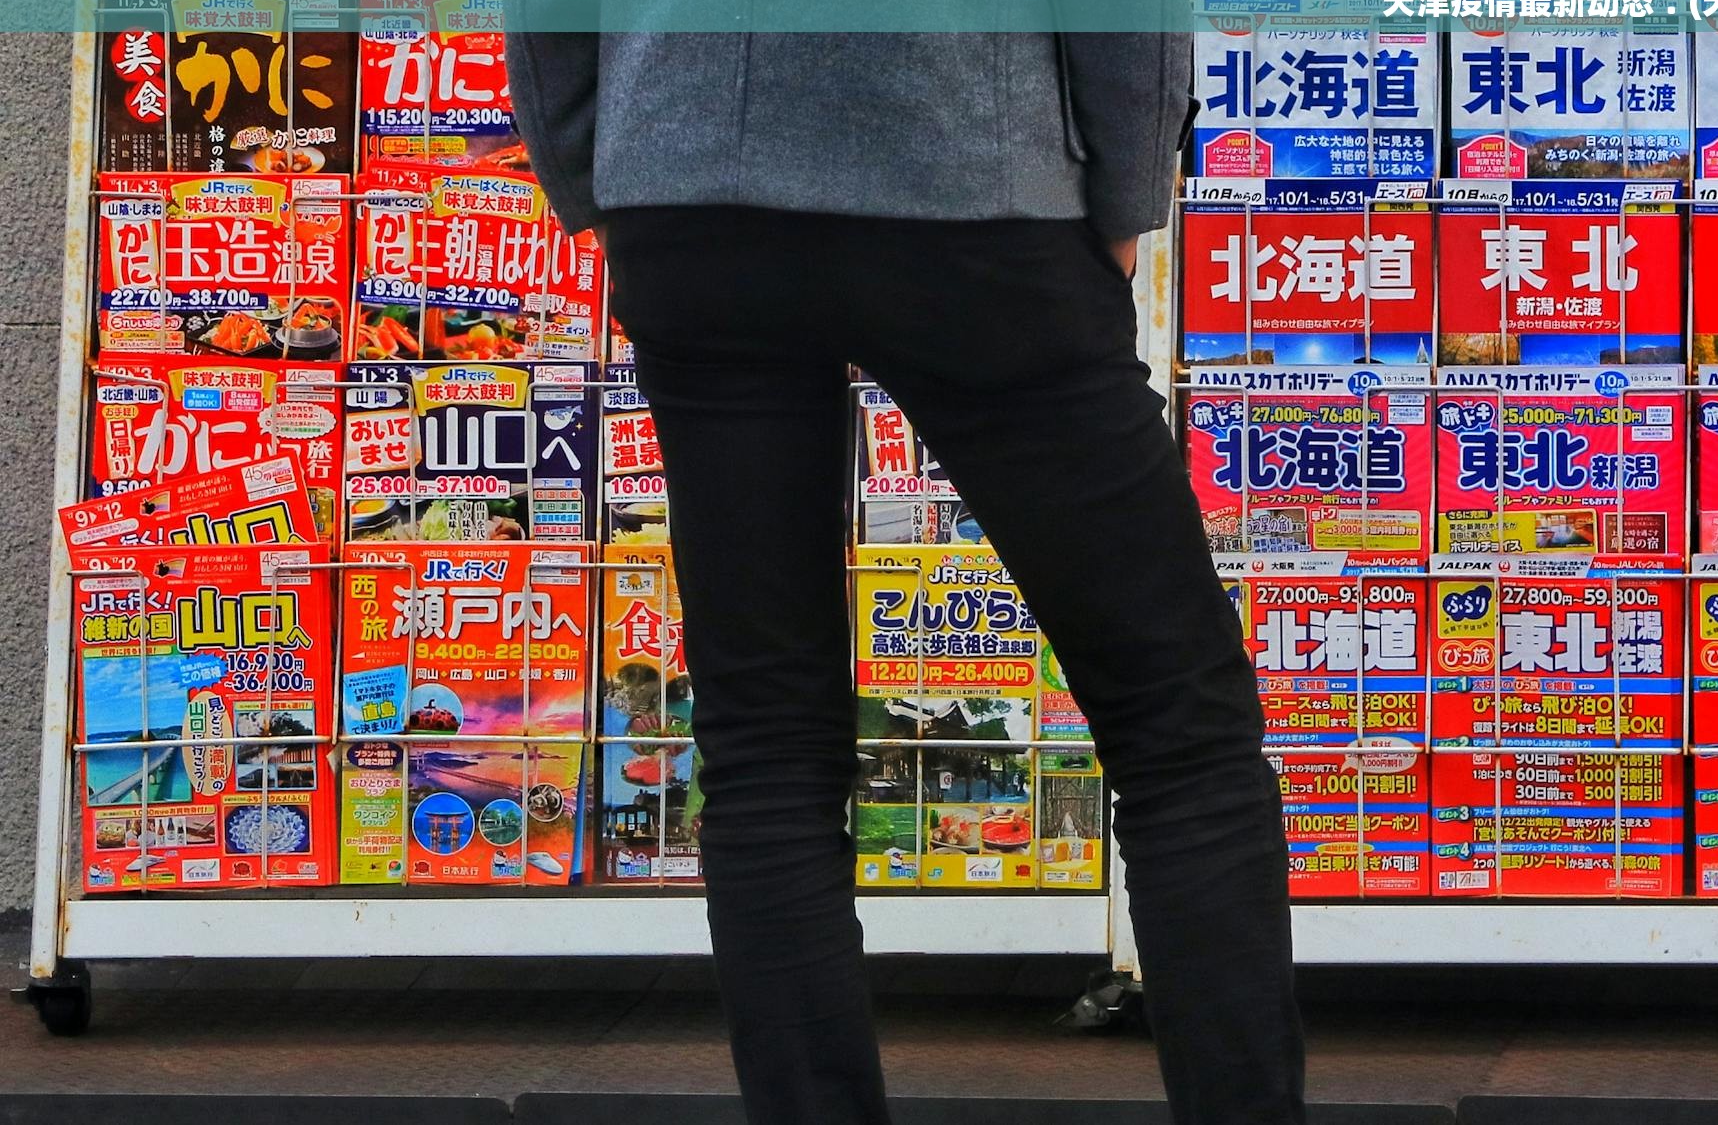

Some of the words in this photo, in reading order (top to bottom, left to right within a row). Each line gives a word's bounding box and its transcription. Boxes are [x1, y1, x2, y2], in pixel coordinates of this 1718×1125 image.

[116, 31, 166, 119] 美食
[176, 41, 334, 123] かに
[1206, 49, 1419, 120] 北海道
[1462, 47, 1605, 115] 東北
[185, 195, 273, 214] 味覚太鼓判
[443, 191, 533, 214] 味覚太鼓判
[166, 222, 271, 284] 玉造
[1210, 233, 1416, 303] 北海道
[1480, 225, 1639, 292] 東北
[1516, 296, 1602, 317] 新潟・佐渡
[426, 383, 516, 401] 味覚太鼓判
[442, 369, 495, 381] JRで行く
[426, 407, 581, 471] 山口へ
[874, 409, 907, 473] 紀州
[1214, 428, 1406, 492] 北海道
[1458, 430, 1588, 491] 東北
[1437, 561, 1493, 572] JALPAK
[81, 591, 173, 613] JRで行く!
[177, 586, 311, 651] 山口へ
[393, 584, 583, 641] 瀬戸内へ
[1256, 610, 1417, 673] 北海道
